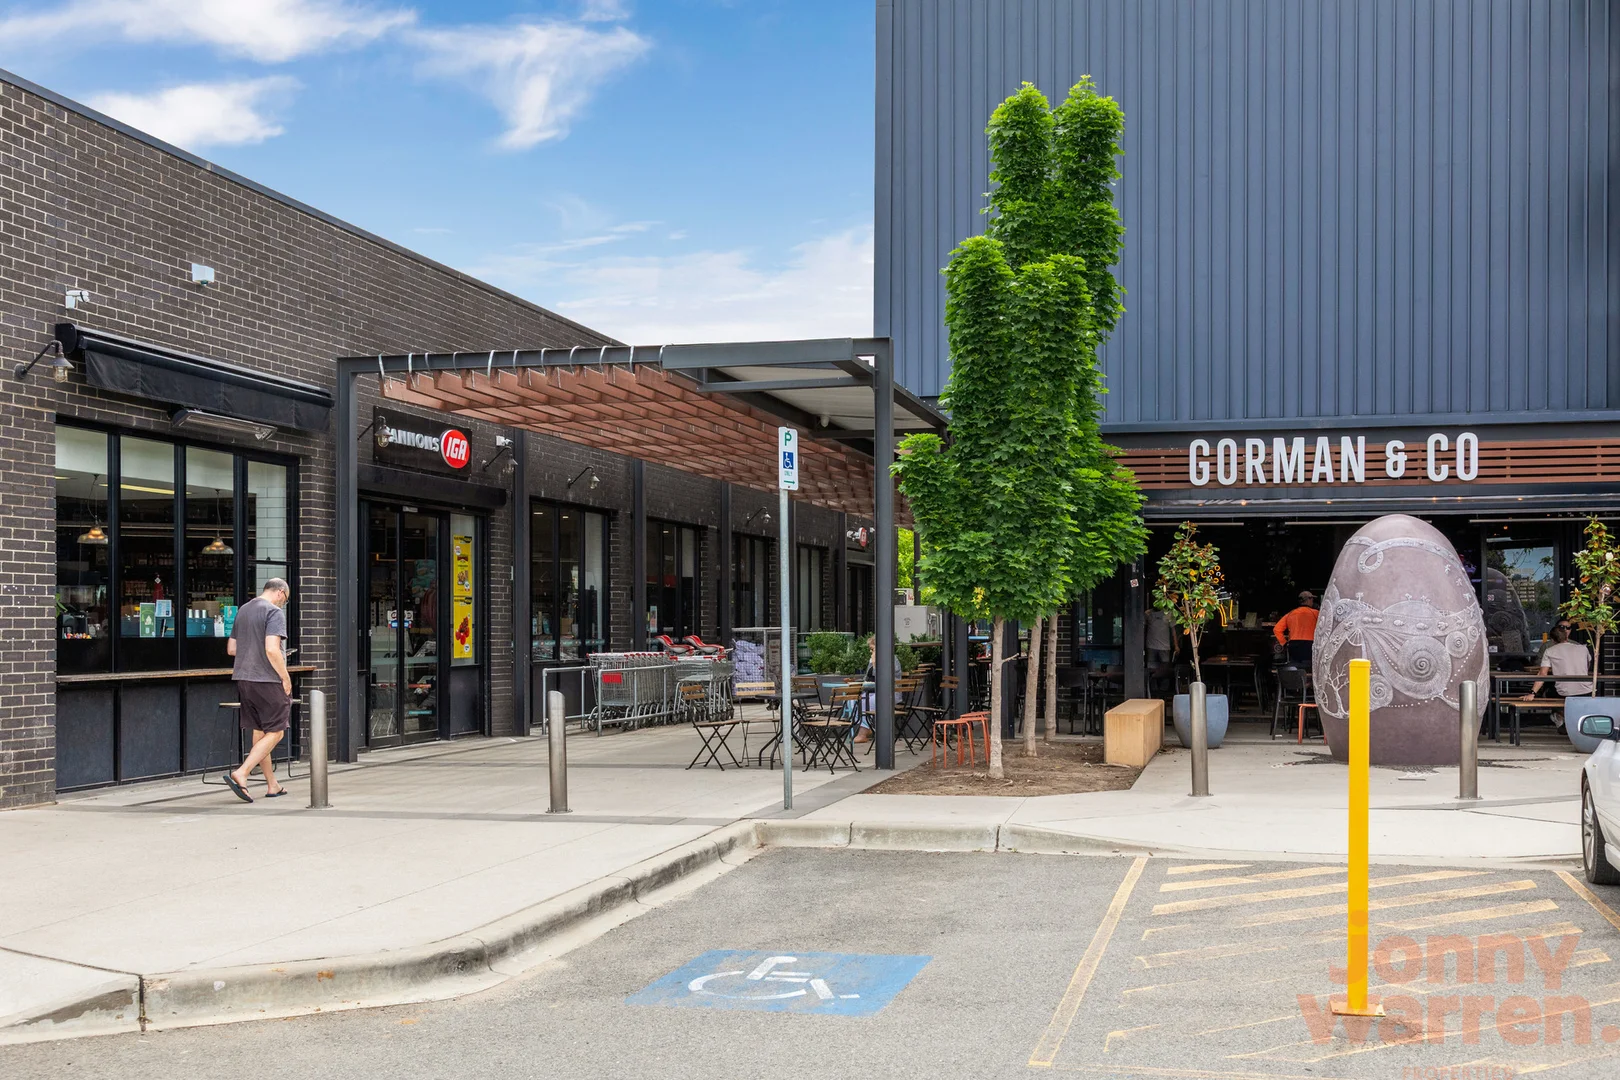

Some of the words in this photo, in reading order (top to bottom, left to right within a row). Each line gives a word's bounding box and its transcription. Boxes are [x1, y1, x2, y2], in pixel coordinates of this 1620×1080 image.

[446, 436, 467, 460] IGA
[784, 432, 792, 446] P
[1189, 435, 1366, 486] GORMAN
[1385, 440, 1408, 479] &
[1426, 432, 1479, 482] CO
